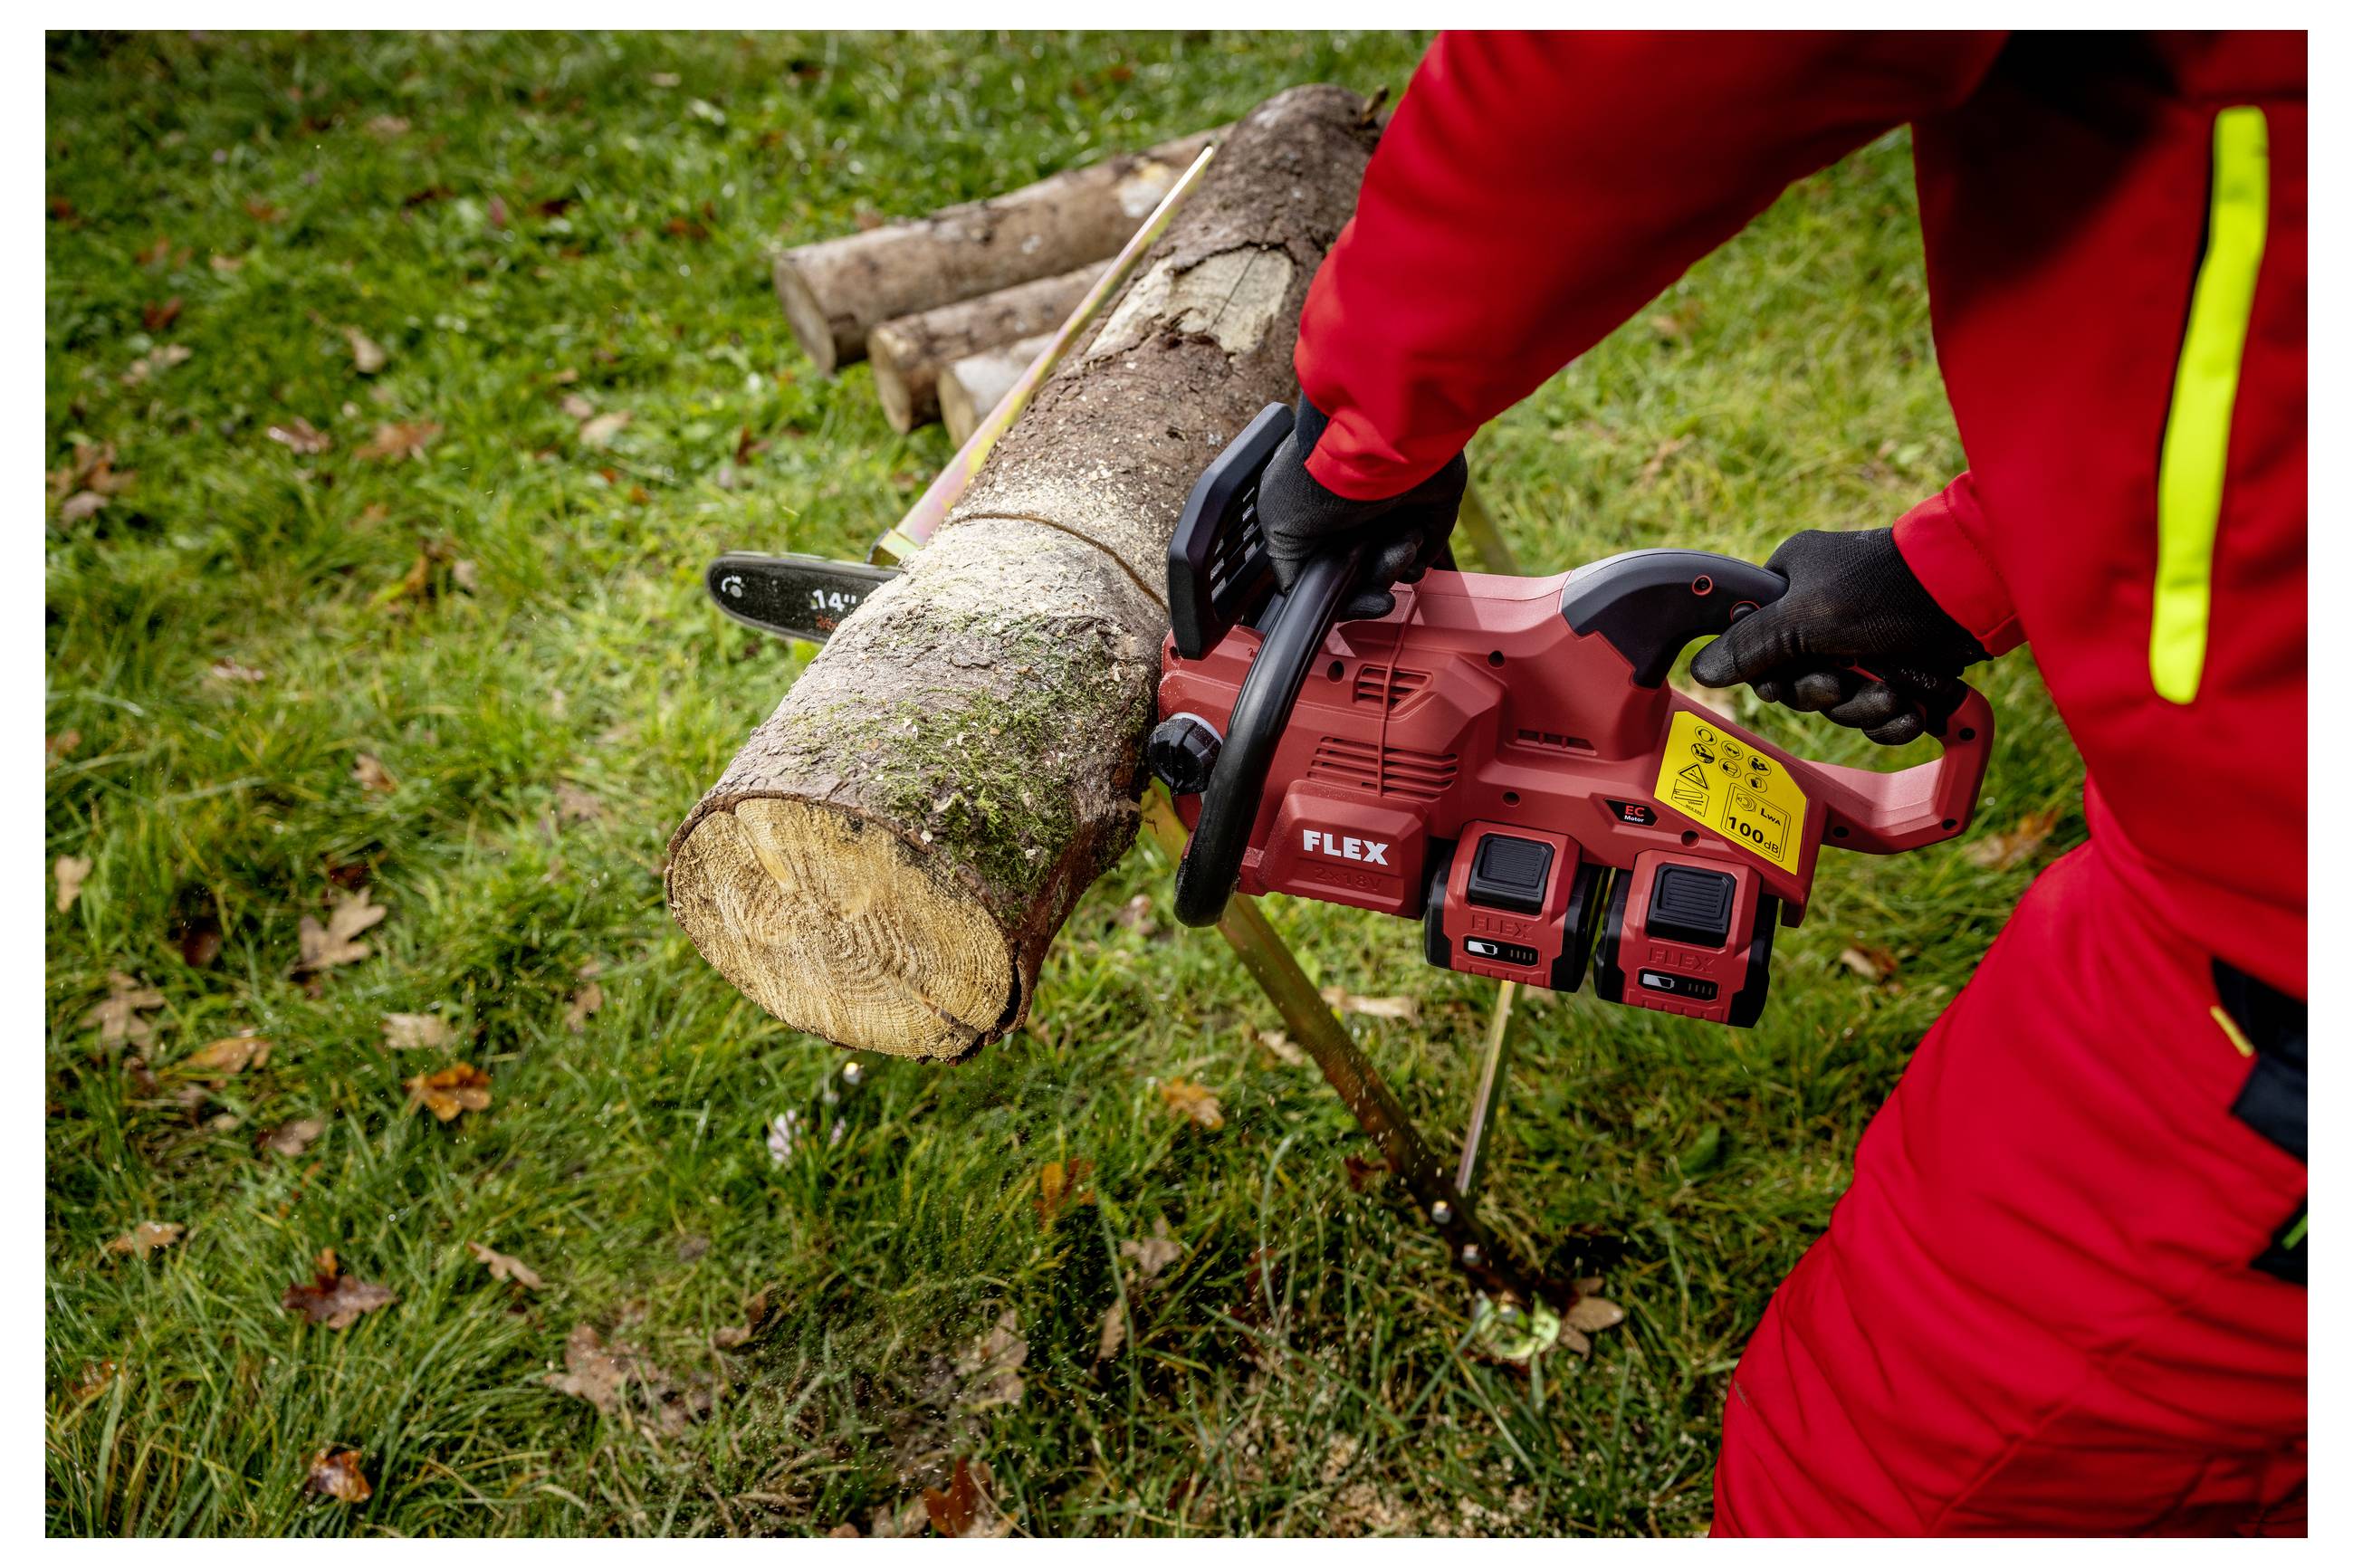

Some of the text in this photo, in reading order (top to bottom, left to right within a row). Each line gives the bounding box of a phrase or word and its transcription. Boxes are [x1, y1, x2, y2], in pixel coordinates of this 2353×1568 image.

[1625, 805, 1645, 817] EC
[1304, 829, 1389, 865] FLEX
[1728, 817, 1779, 854] 100 dB
[1471, 913, 1533, 941] FLEX
[1649, 947, 1715, 973] FLEX
